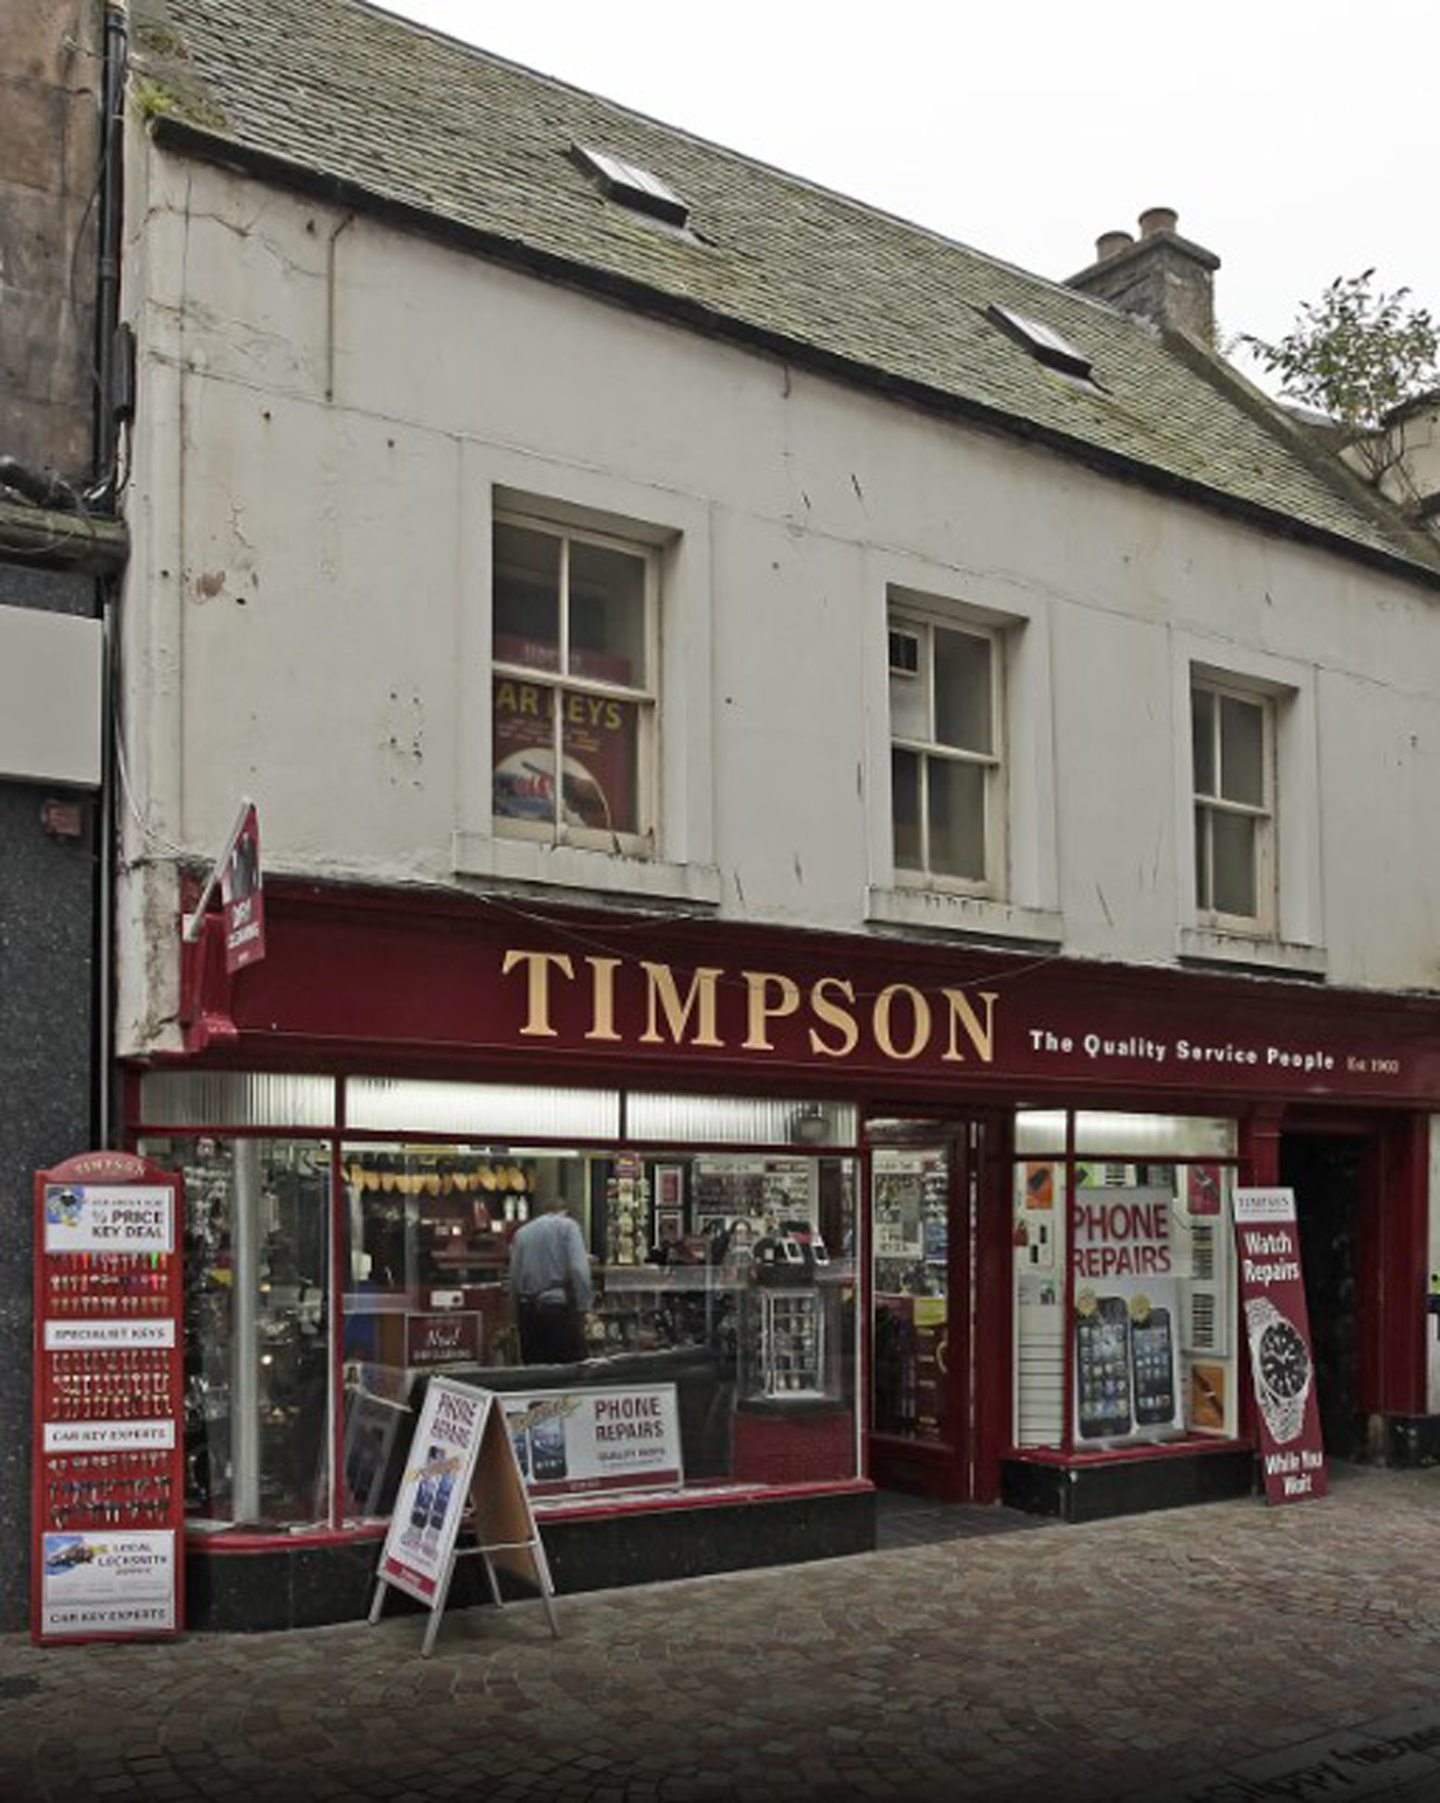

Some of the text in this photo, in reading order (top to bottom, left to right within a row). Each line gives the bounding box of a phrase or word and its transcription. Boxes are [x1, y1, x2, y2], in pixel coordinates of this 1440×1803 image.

[497, 682, 538, 715] AR
[502, 949, 999, 1063] TIMPSON
[1029, 1029, 1073, 1052] The
[1084, 1034, 1166, 1062] Quality
[1177, 1039, 1258, 1064] Service
[1267, 1046, 1334, 1072] People
[112, 1209, 162, 1225] PRICE
[1074, 1203, 1168, 1241] PHONE
[91, 1225, 162, 1240] KEY DEAL
[1244, 1231, 1292, 1255] Watch
[1073, 1245, 1172, 1278] REPAIRS
[1243, 1258, 1300, 1287] Repairs
[595, 1397, 662, 1420] PHONE
[595, 1420, 664, 1442] REPAIRS
[1265, 1450, 1323, 1475] While You
